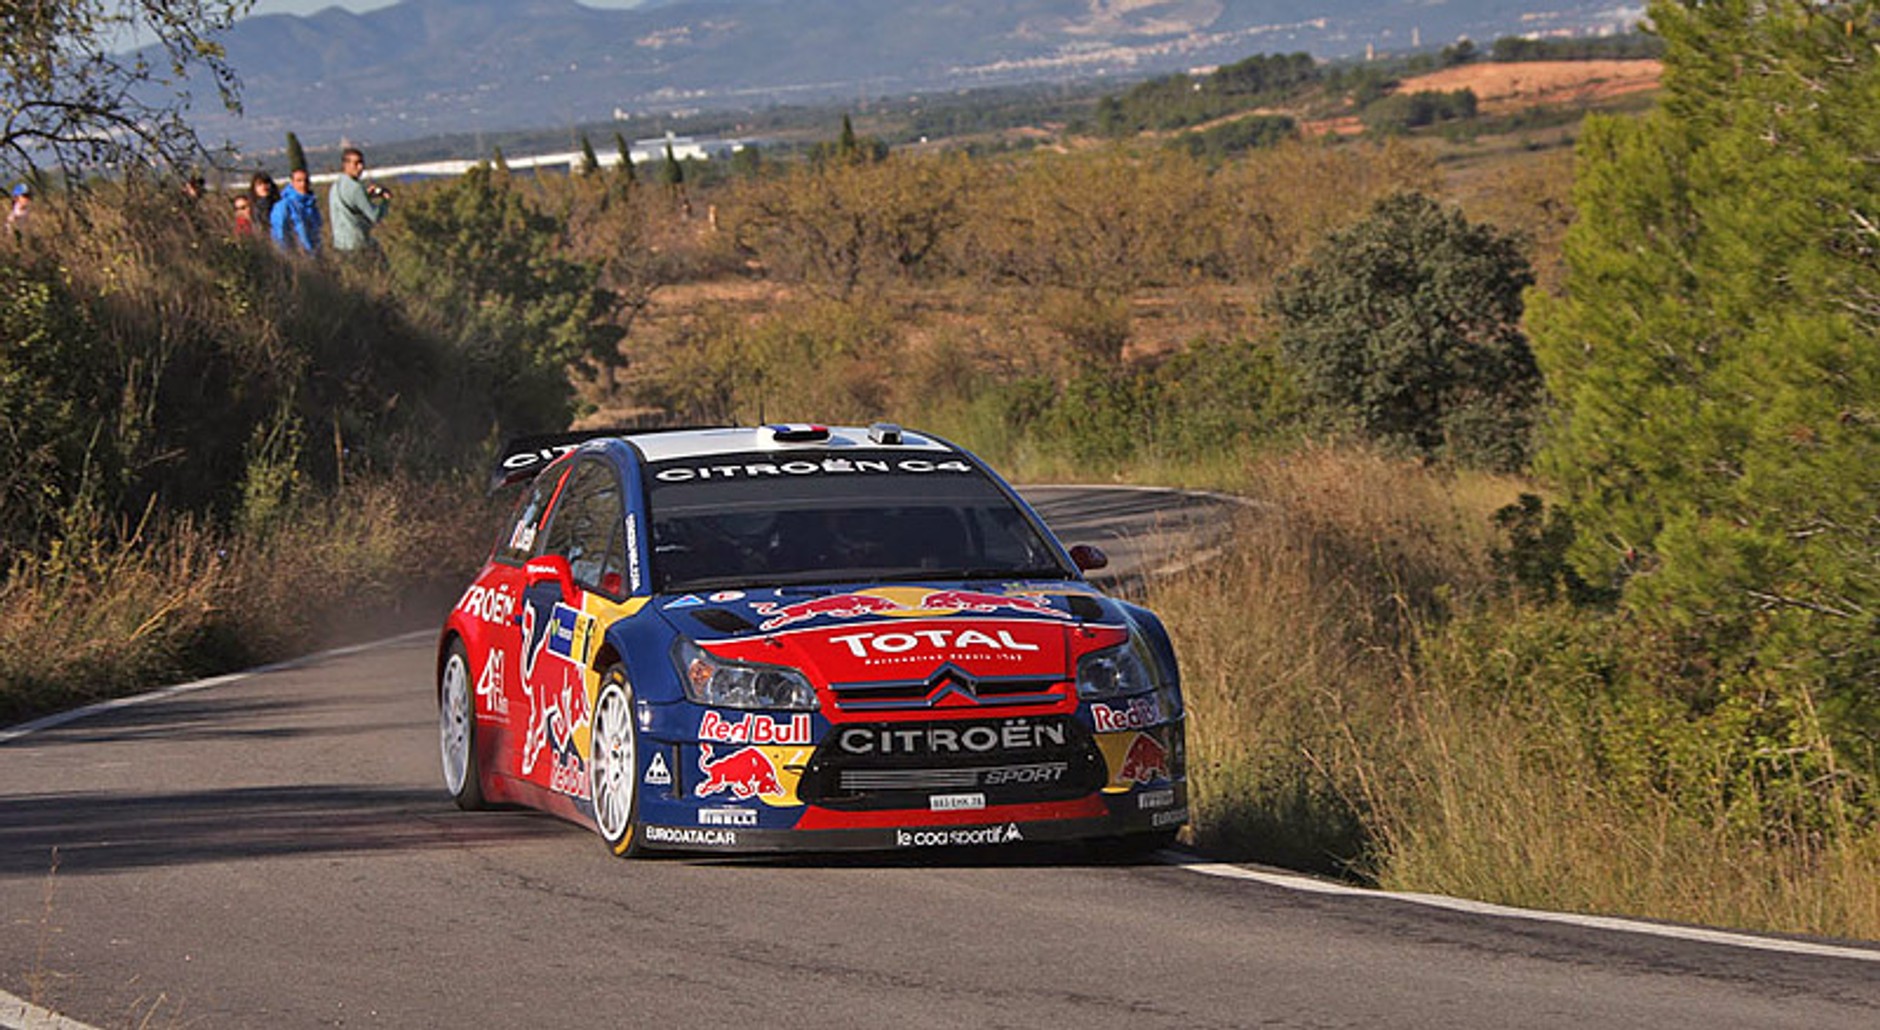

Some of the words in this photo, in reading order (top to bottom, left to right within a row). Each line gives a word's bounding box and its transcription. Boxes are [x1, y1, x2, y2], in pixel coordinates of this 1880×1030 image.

[655, 458, 890, 482] CITROËN
[898, 459, 972, 473] C4
[828, 630, 1040, 657] TOTAL
[698, 710, 752, 743] Red
[752, 713, 812, 744] Bull
[1090, 699, 1142, 733] Red
[839, 719, 1067, 753] CITROËN
[984, 764, 1067, 785] SPORT
[646, 826, 736, 845] EURODATACAR
[897, 830, 912, 846] le
